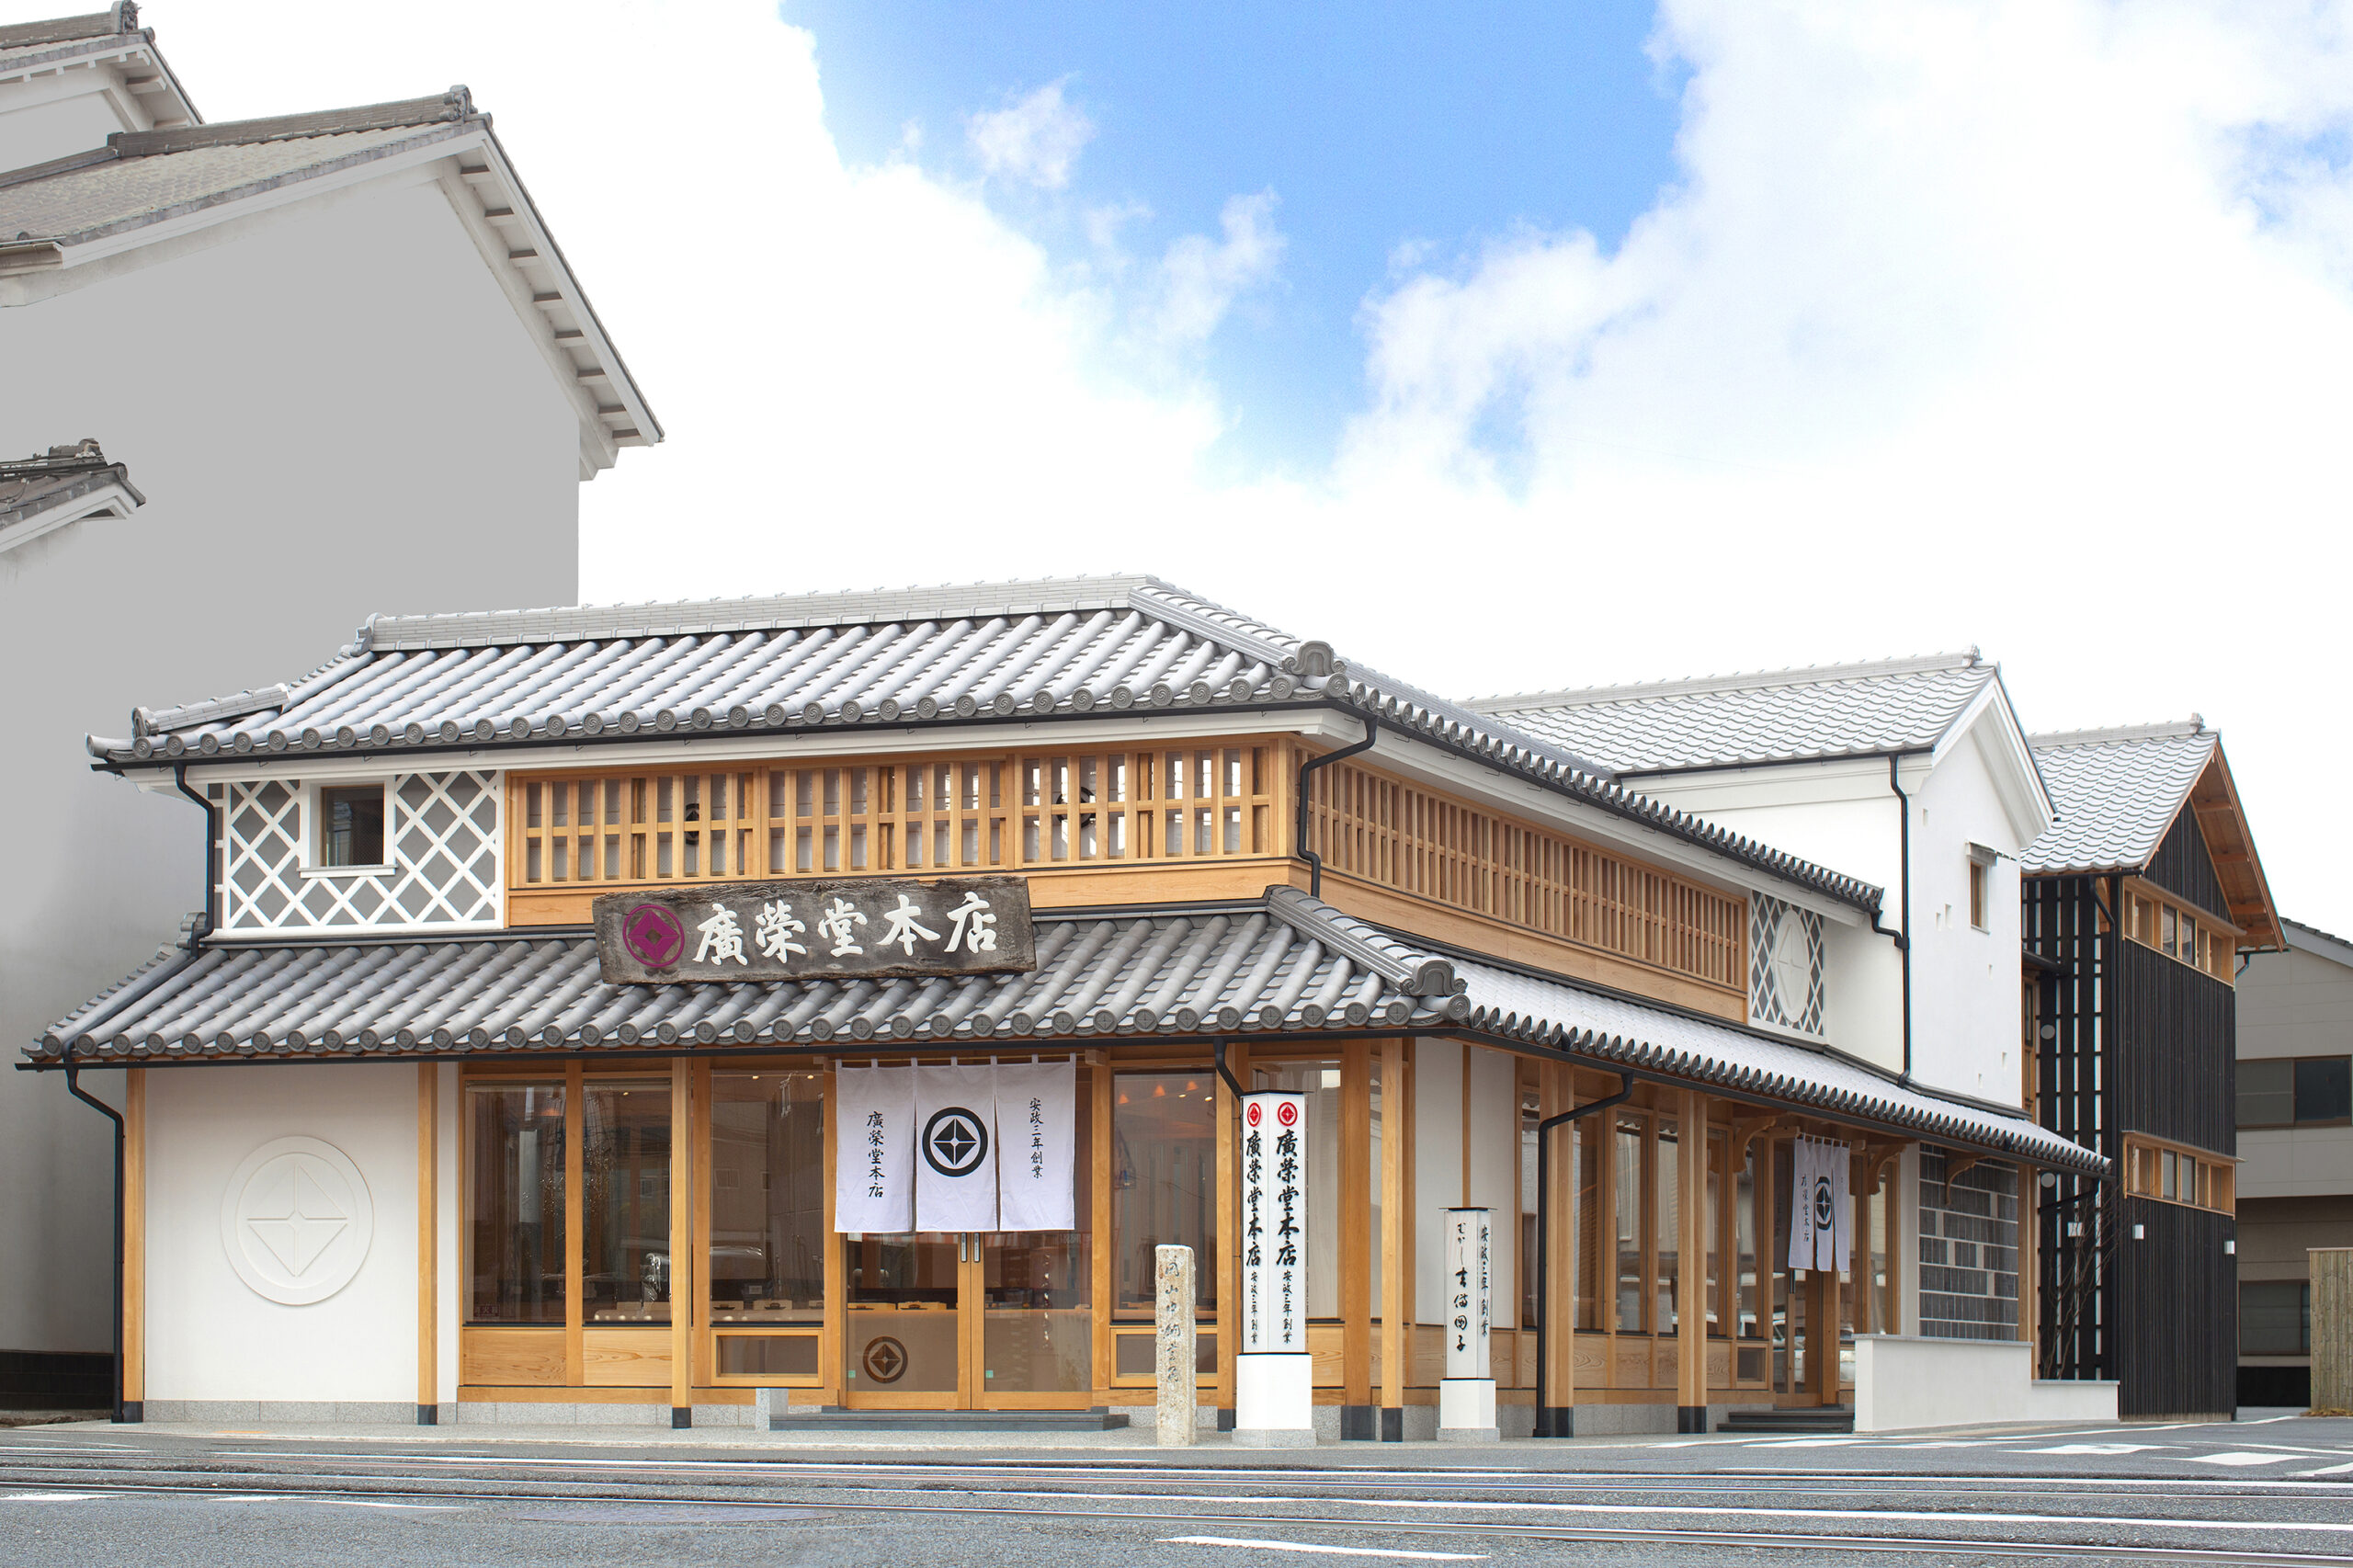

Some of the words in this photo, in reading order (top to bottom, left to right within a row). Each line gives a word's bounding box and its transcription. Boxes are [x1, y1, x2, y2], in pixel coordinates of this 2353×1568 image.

[691, 891, 998, 966] 廣榮堂本店
[866, 1109, 886, 1199] 廣榮堂本店
[1029, 1096, 1045, 1180] 安政三年創業
[1245, 1128, 1264, 1267] 廣榮堂本店
[1275, 1127, 1301, 1267] 廣榮堂本店
[1249, 1269, 1259, 1345] 安政三年創業
[1281, 1268, 1294, 1345] 安政三年創業
